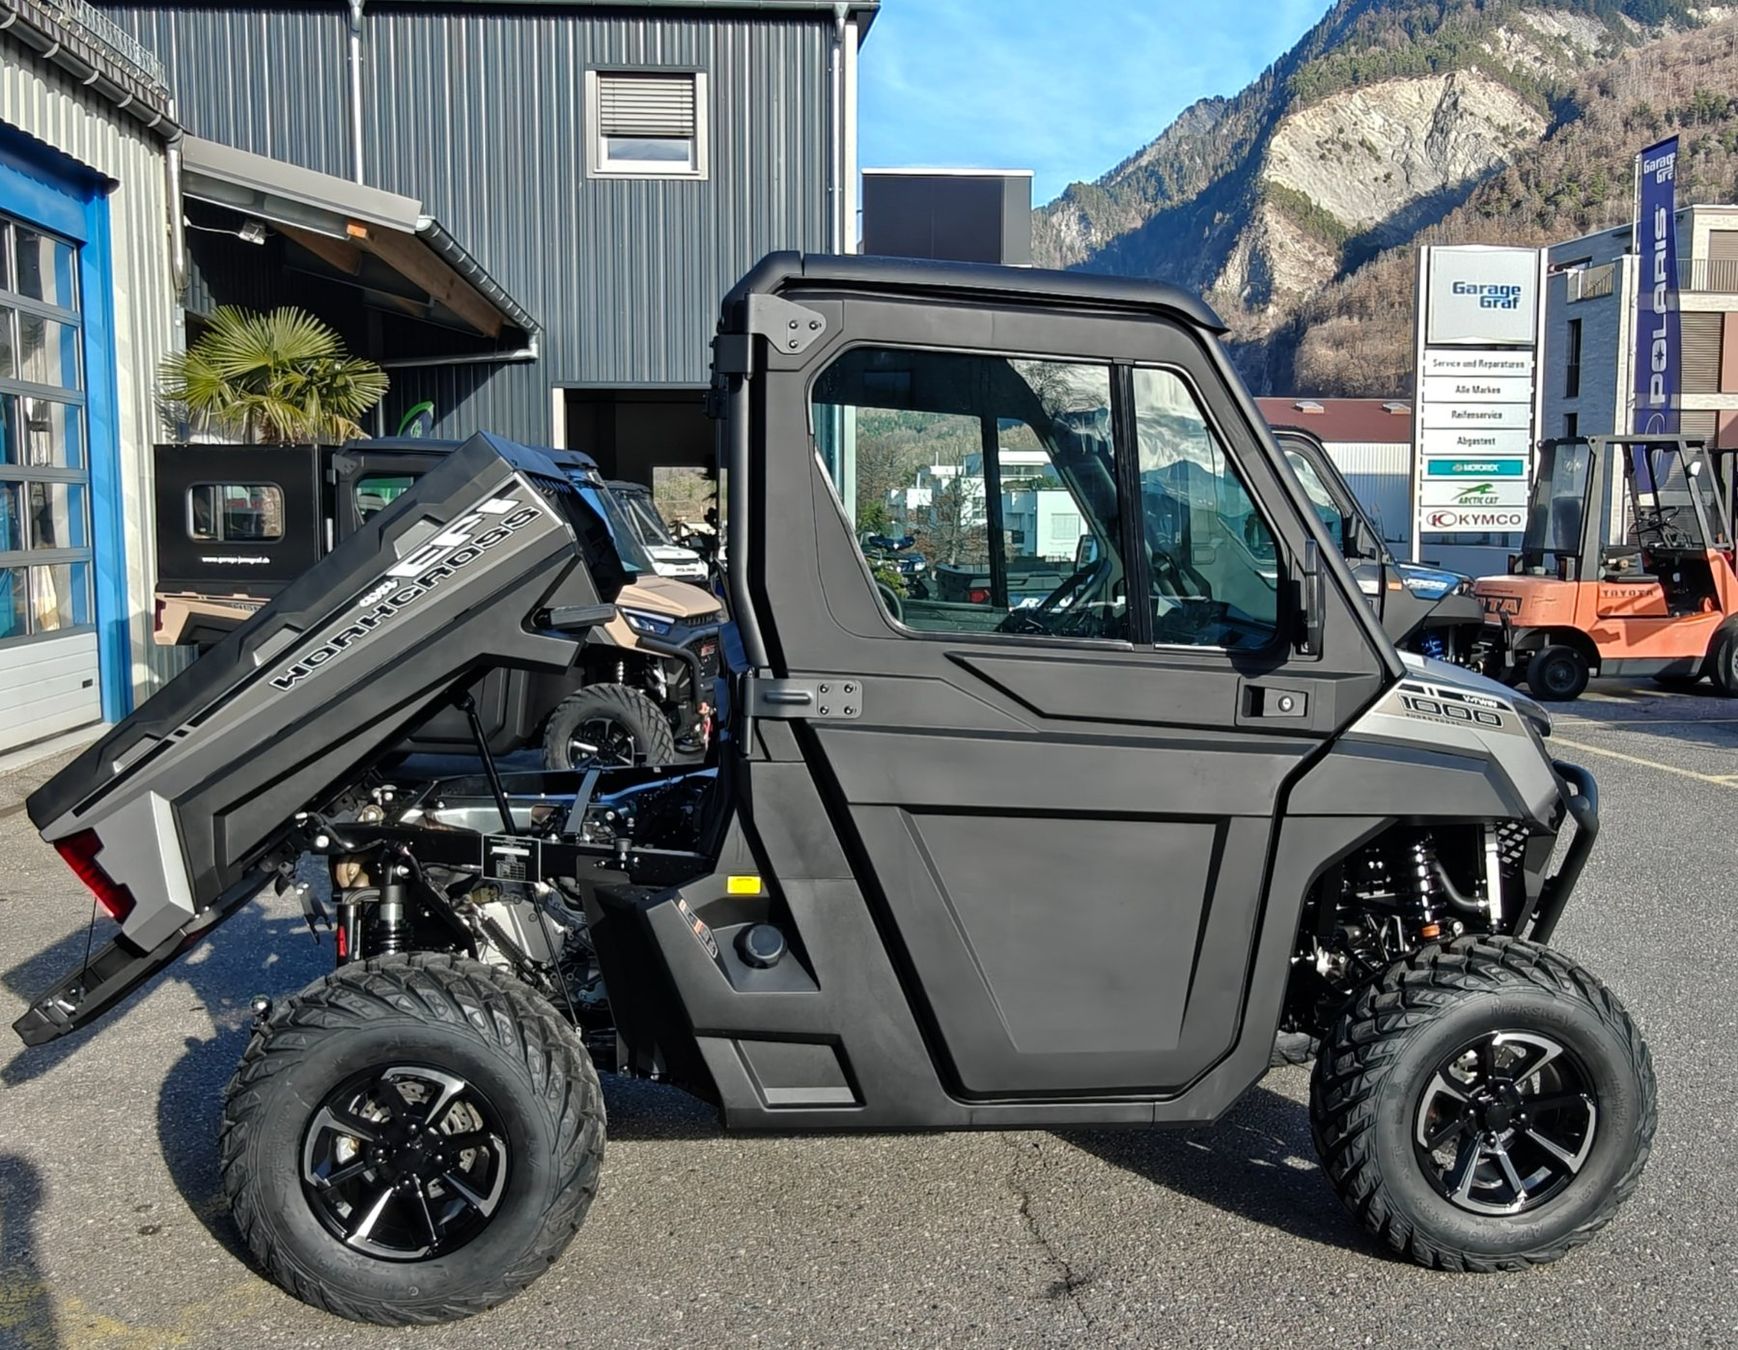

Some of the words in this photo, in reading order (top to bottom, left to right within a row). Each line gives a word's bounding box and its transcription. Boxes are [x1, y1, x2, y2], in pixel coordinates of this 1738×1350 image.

[1656, 167, 1674, 184] Gra
[1452, 281, 1521, 298] Garage
[1479, 296, 1520, 309] Graf
[1650, 206, 1668, 404] POLARIS
[1433, 359, 1460, 368] Service
[1462, 360, 1477, 368] und
[1478, 359, 1525, 370] Reparaturen
[1455, 385, 1470, 394] Alle
[1472, 385, 1501, 394] Marken
[1451, 410, 1503, 419] Reifenservice
[1457, 436, 1496, 447] Abgastest
[1458, 496, 1484, 504] ARCTIC
[1484, 496, 1499, 504] CAT
[1458, 514, 1522, 525] KYMCO
[1602, 589, 1654, 598] TOYOTA
[1400, 694, 1503, 727] 1000
